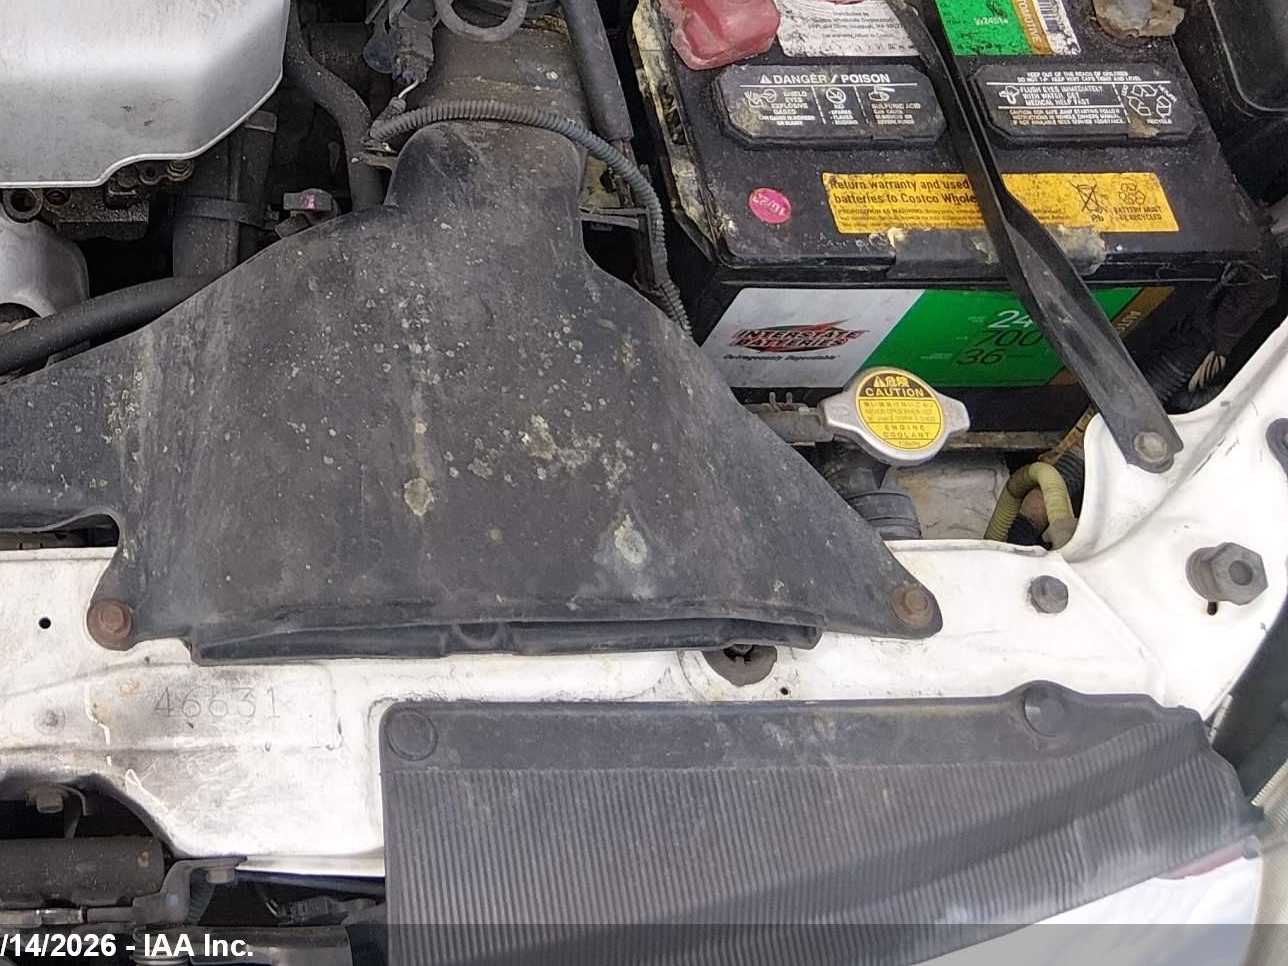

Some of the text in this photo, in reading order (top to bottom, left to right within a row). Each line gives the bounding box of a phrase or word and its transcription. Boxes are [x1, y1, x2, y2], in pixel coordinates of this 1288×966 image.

[773, 74, 891, 84] DANGER / POISON
[831, 178, 969, 192] Return warranty and used
[834, 192, 978, 205] batteries to Costco Whole
[734, 329, 866, 339] INTERSTATE
[975, 330, 1042, 347] 700
[729, 338, 849, 346] BATTERIES
[956, 348, 1005, 365] 36
[865, 387, 925, 397] CAUTION
[154, 683, 281, 720] 46631
